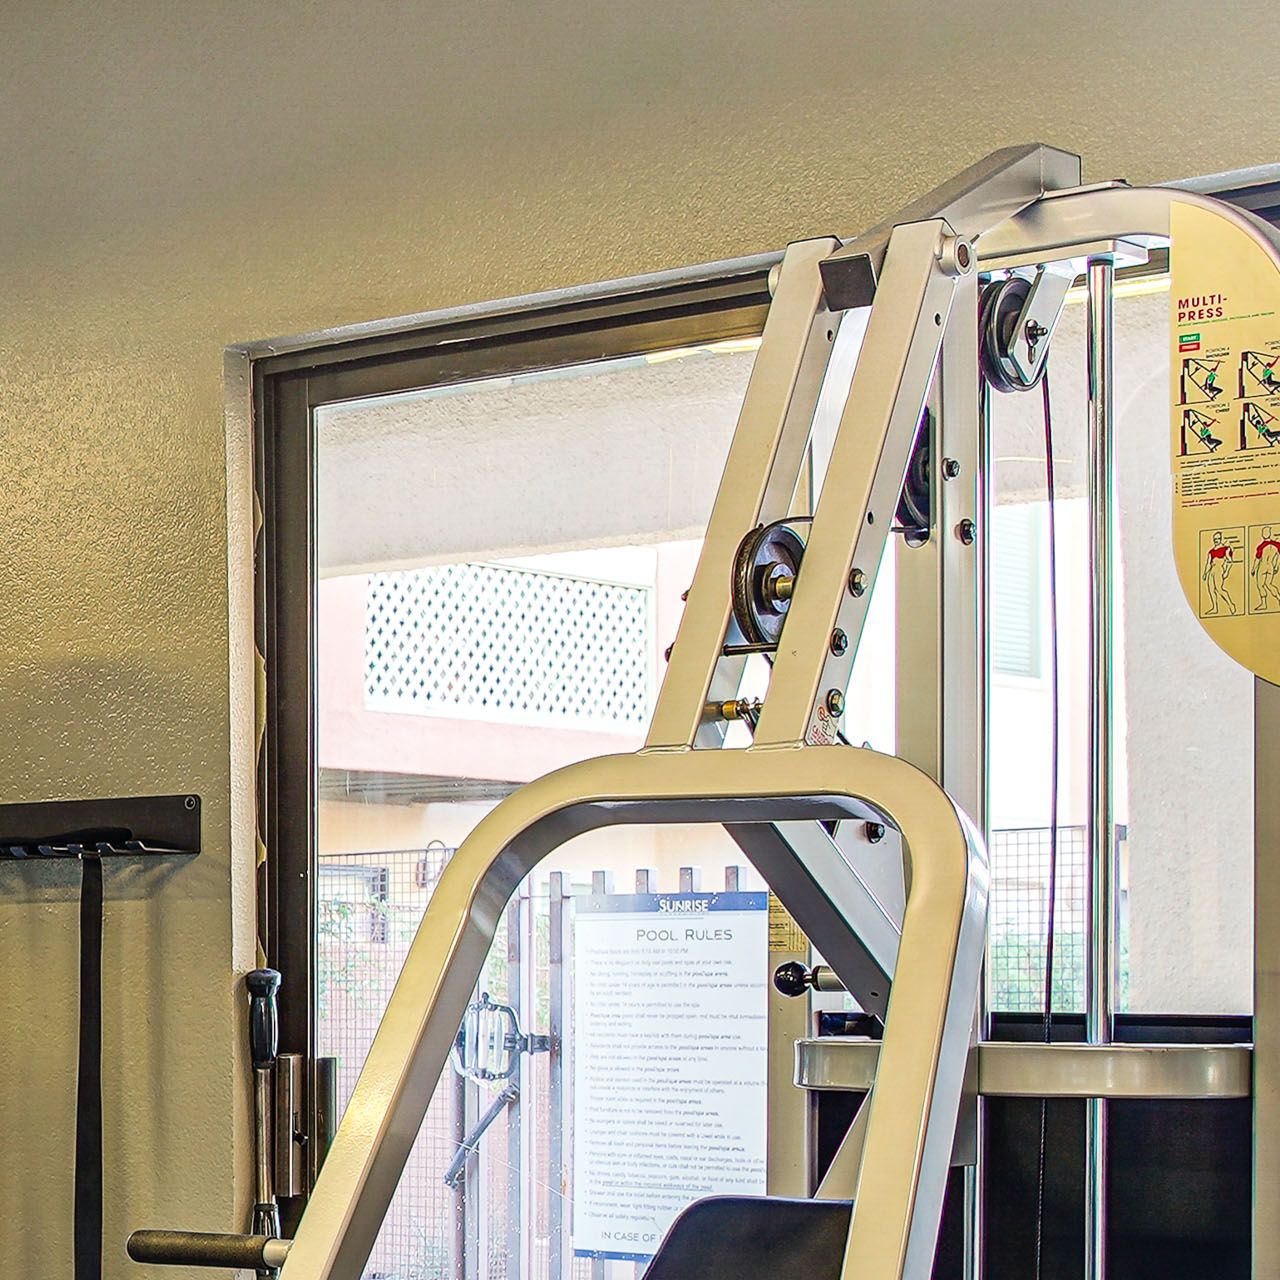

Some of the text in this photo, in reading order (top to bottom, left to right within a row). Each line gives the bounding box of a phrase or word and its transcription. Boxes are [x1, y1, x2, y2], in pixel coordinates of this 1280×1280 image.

[1178, 294, 1227, 309] MULTI-
[1178, 307, 1223, 322] PRESS
[658, 899, 709, 912] SUNRISE
[636, 929, 733, 941] POOL RULES
[601, 1231, 655, 1242] IN CASE OF
